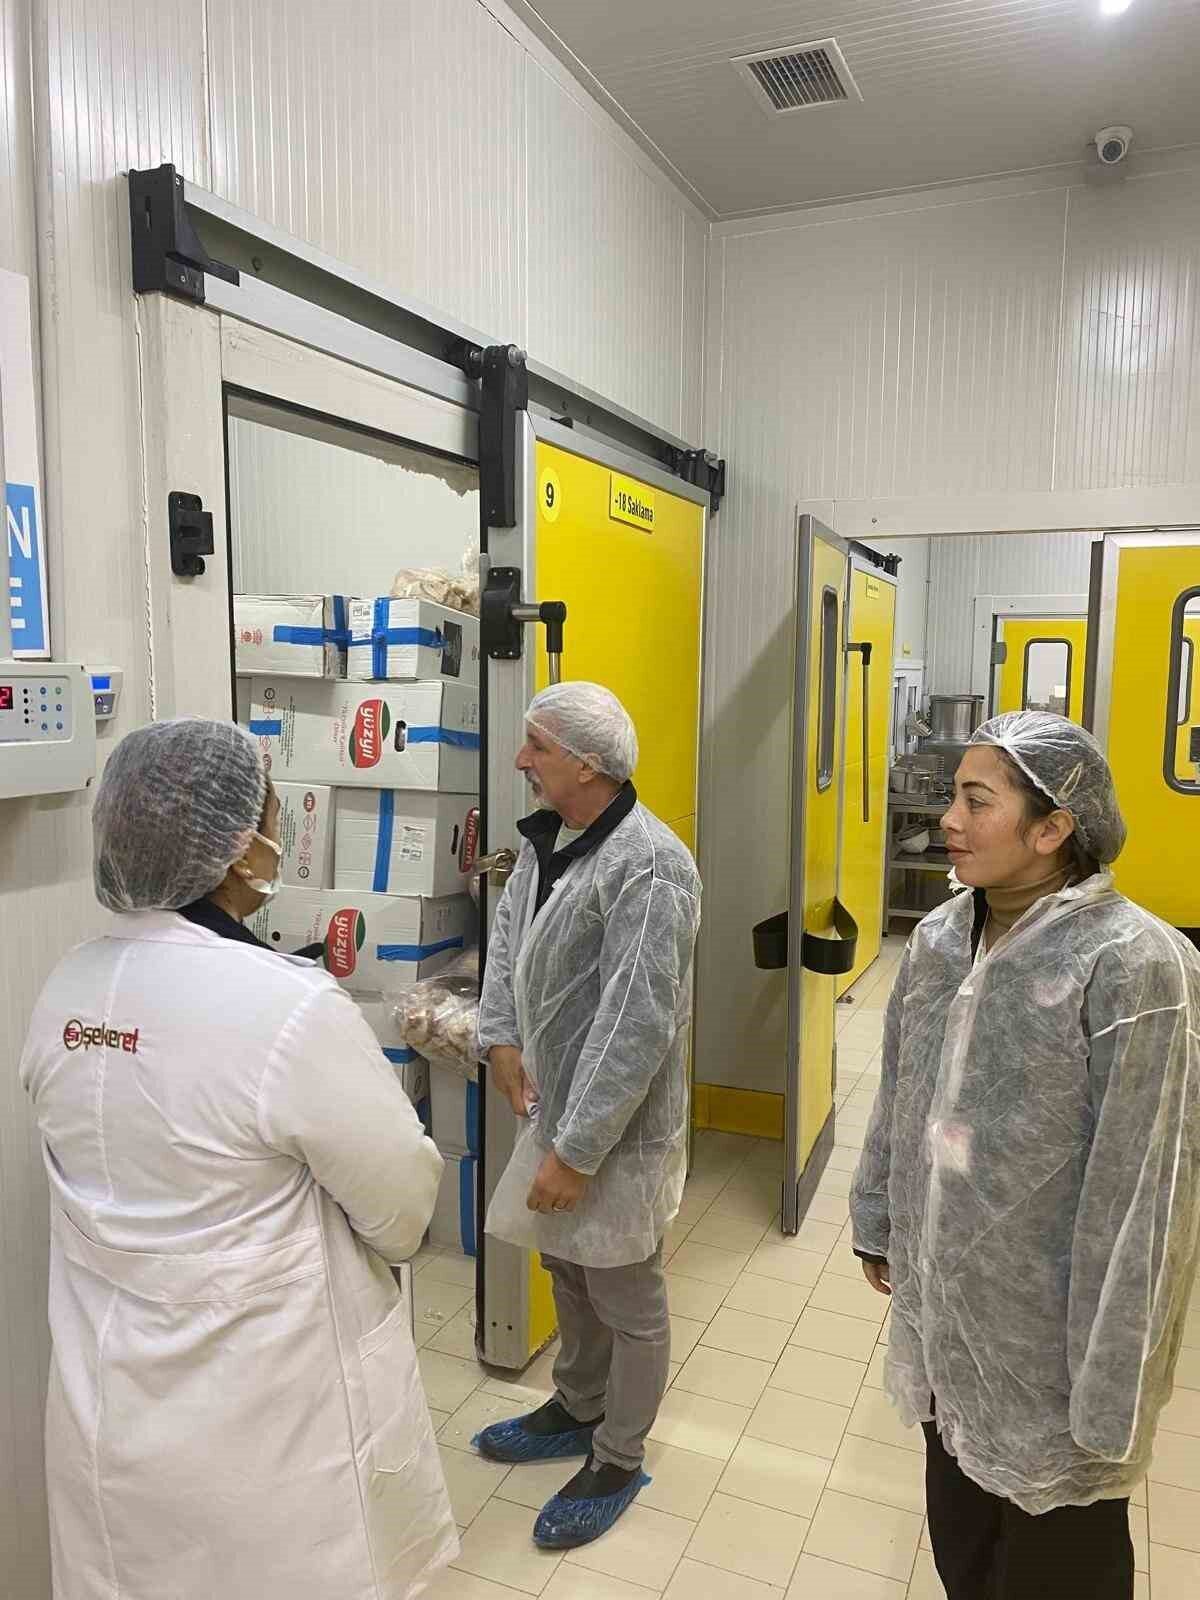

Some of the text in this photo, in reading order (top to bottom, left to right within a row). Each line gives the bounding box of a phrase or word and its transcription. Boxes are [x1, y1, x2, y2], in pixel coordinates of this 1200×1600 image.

[545, 482, 555, 508] 9
[615, 491, 654, 523] -18 Saklama
[332, 915, 349, 970] yüzyıl
